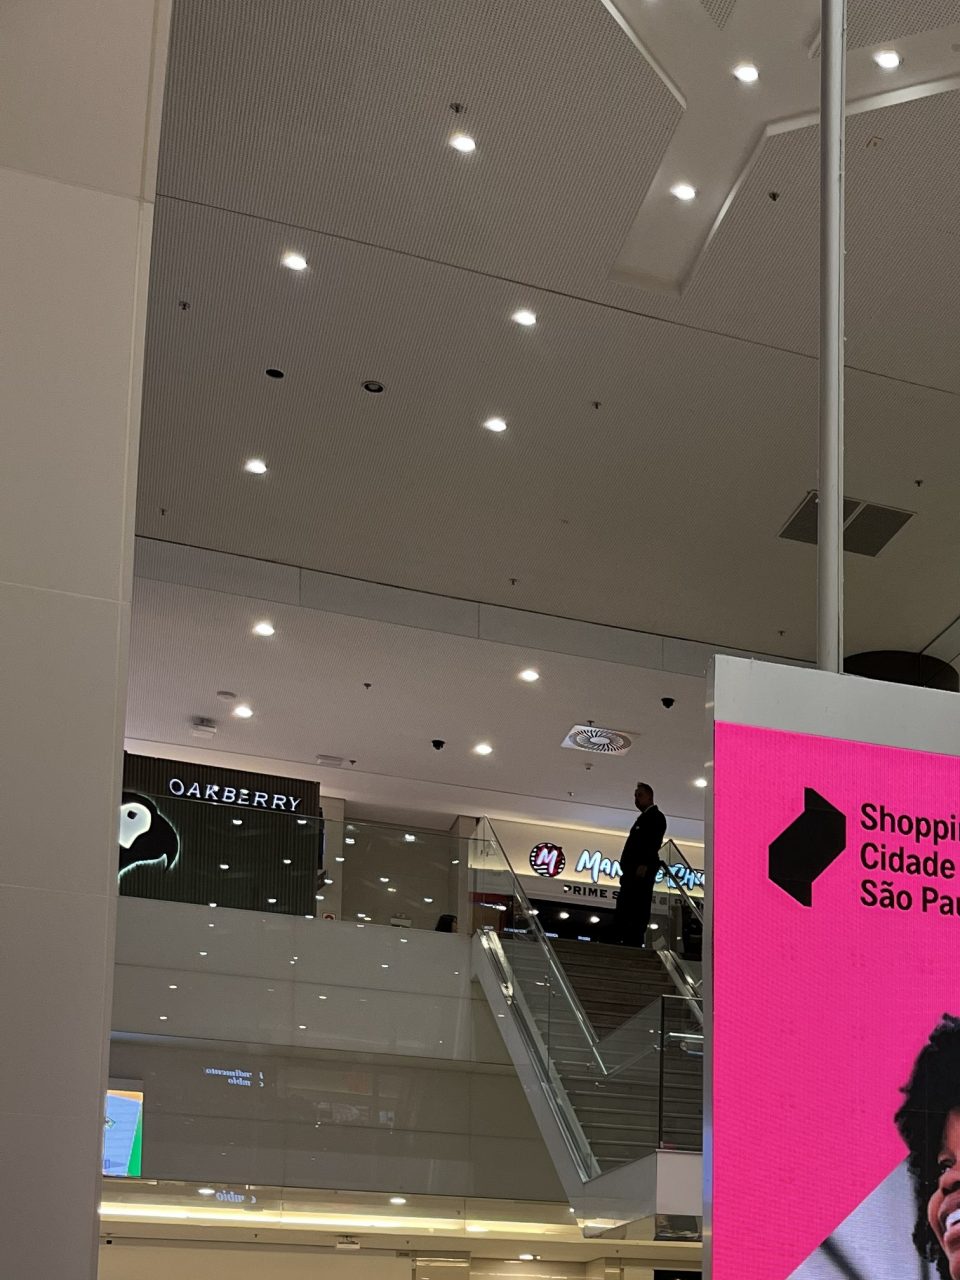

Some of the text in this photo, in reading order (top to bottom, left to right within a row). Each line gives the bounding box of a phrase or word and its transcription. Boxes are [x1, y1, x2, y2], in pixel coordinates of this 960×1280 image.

[169, 778, 302, 812] OAKBERRY
[860, 842, 956, 879] Cidade
[860, 879, 913, 911] São
